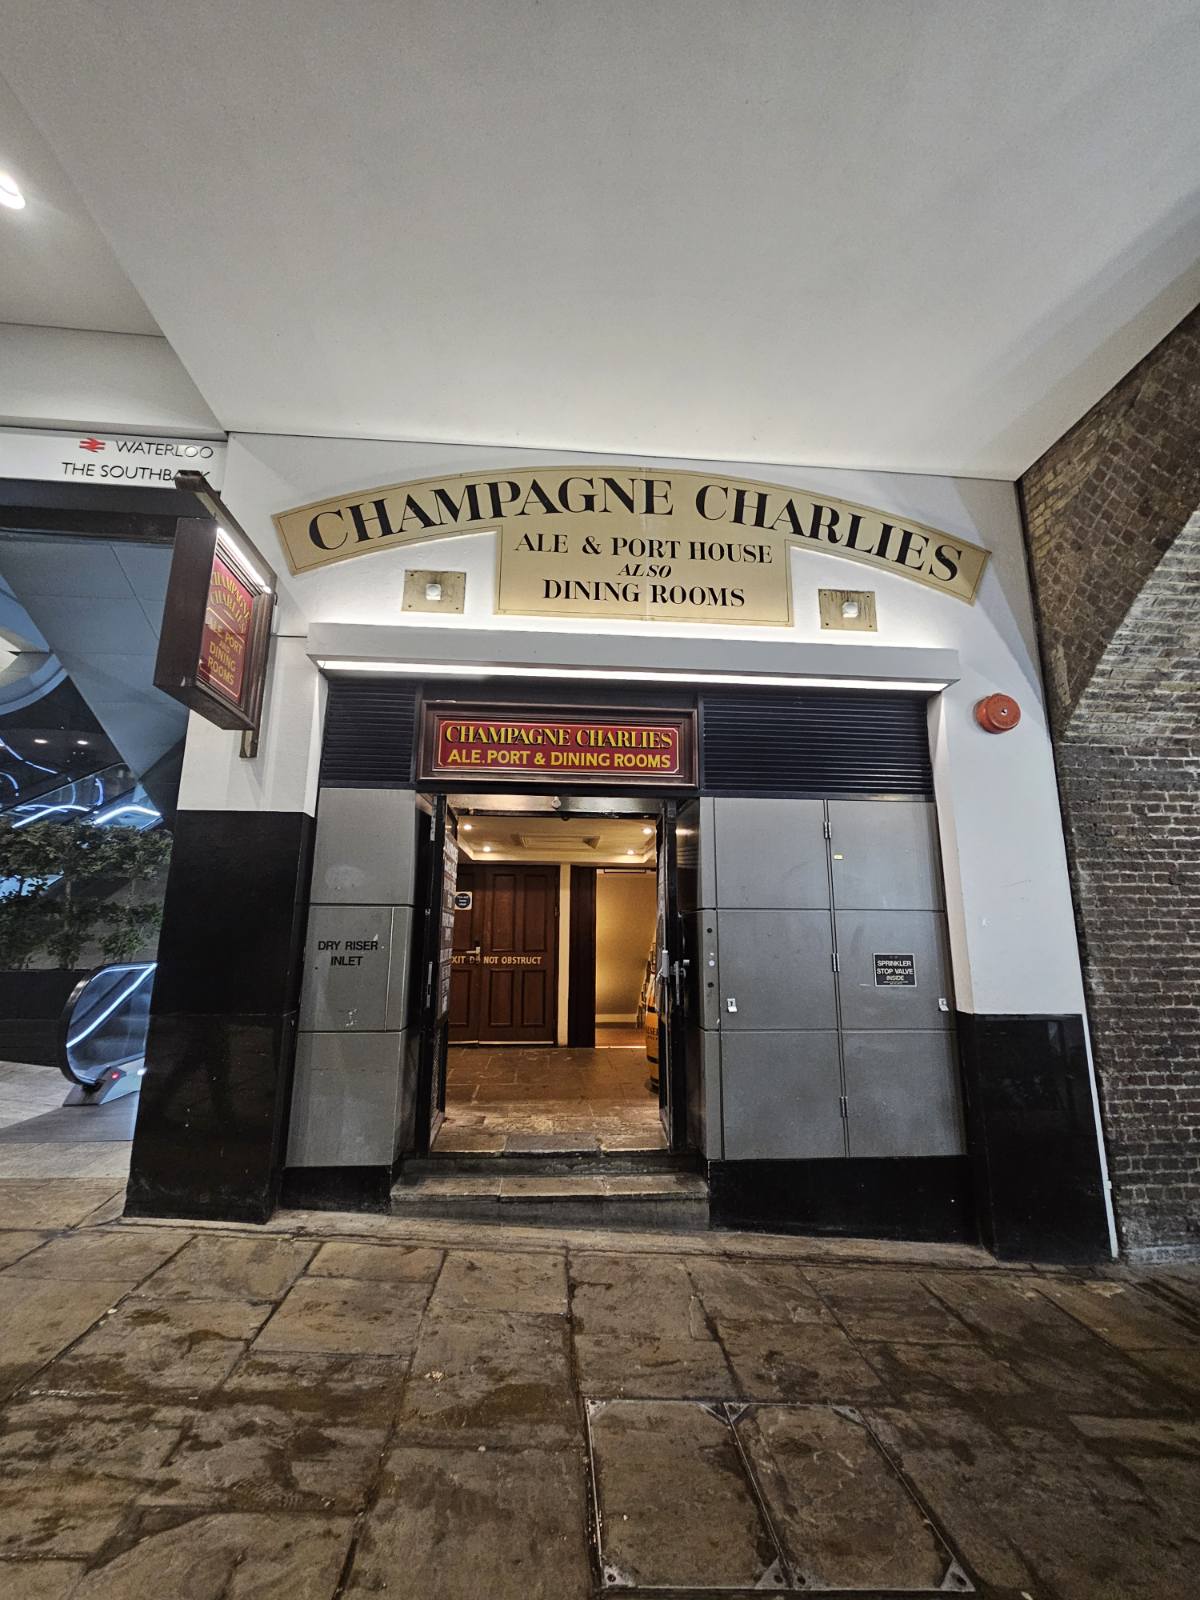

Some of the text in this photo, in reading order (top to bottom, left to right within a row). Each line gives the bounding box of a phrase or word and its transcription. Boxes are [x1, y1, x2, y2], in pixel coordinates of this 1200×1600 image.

[116, 440, 214, 459] WATERLOO
[62, 461, 211, 482] THE SOUTHB
[308, 476, 963, 582] CHAMPAGNE CHARLIES
[514, 533, 773, 564] ALE & PORT HOUSE
[617, 563, 672, 579] ALSO
[542, 578, 745, 608] DINING ROOMS
[224, 633, 243, 655] PORT
[209, 641, 236, 672] DINING
[207, 656, 235, 686] ROOMS
[445, 725, 674, 749] CHAMPAGNE CHARLIES
[533, 752, 546, 765] &
[550, 751, 611, 767] DINING
[614, 753, 671, 768] ROOMS
[318, 940, 378, 951] DRY RISER
[330, 955, 364, 966] INLET
[483, 956, 499, 964] NOT
[501, 956, 542, 965] OBSTRUCT
